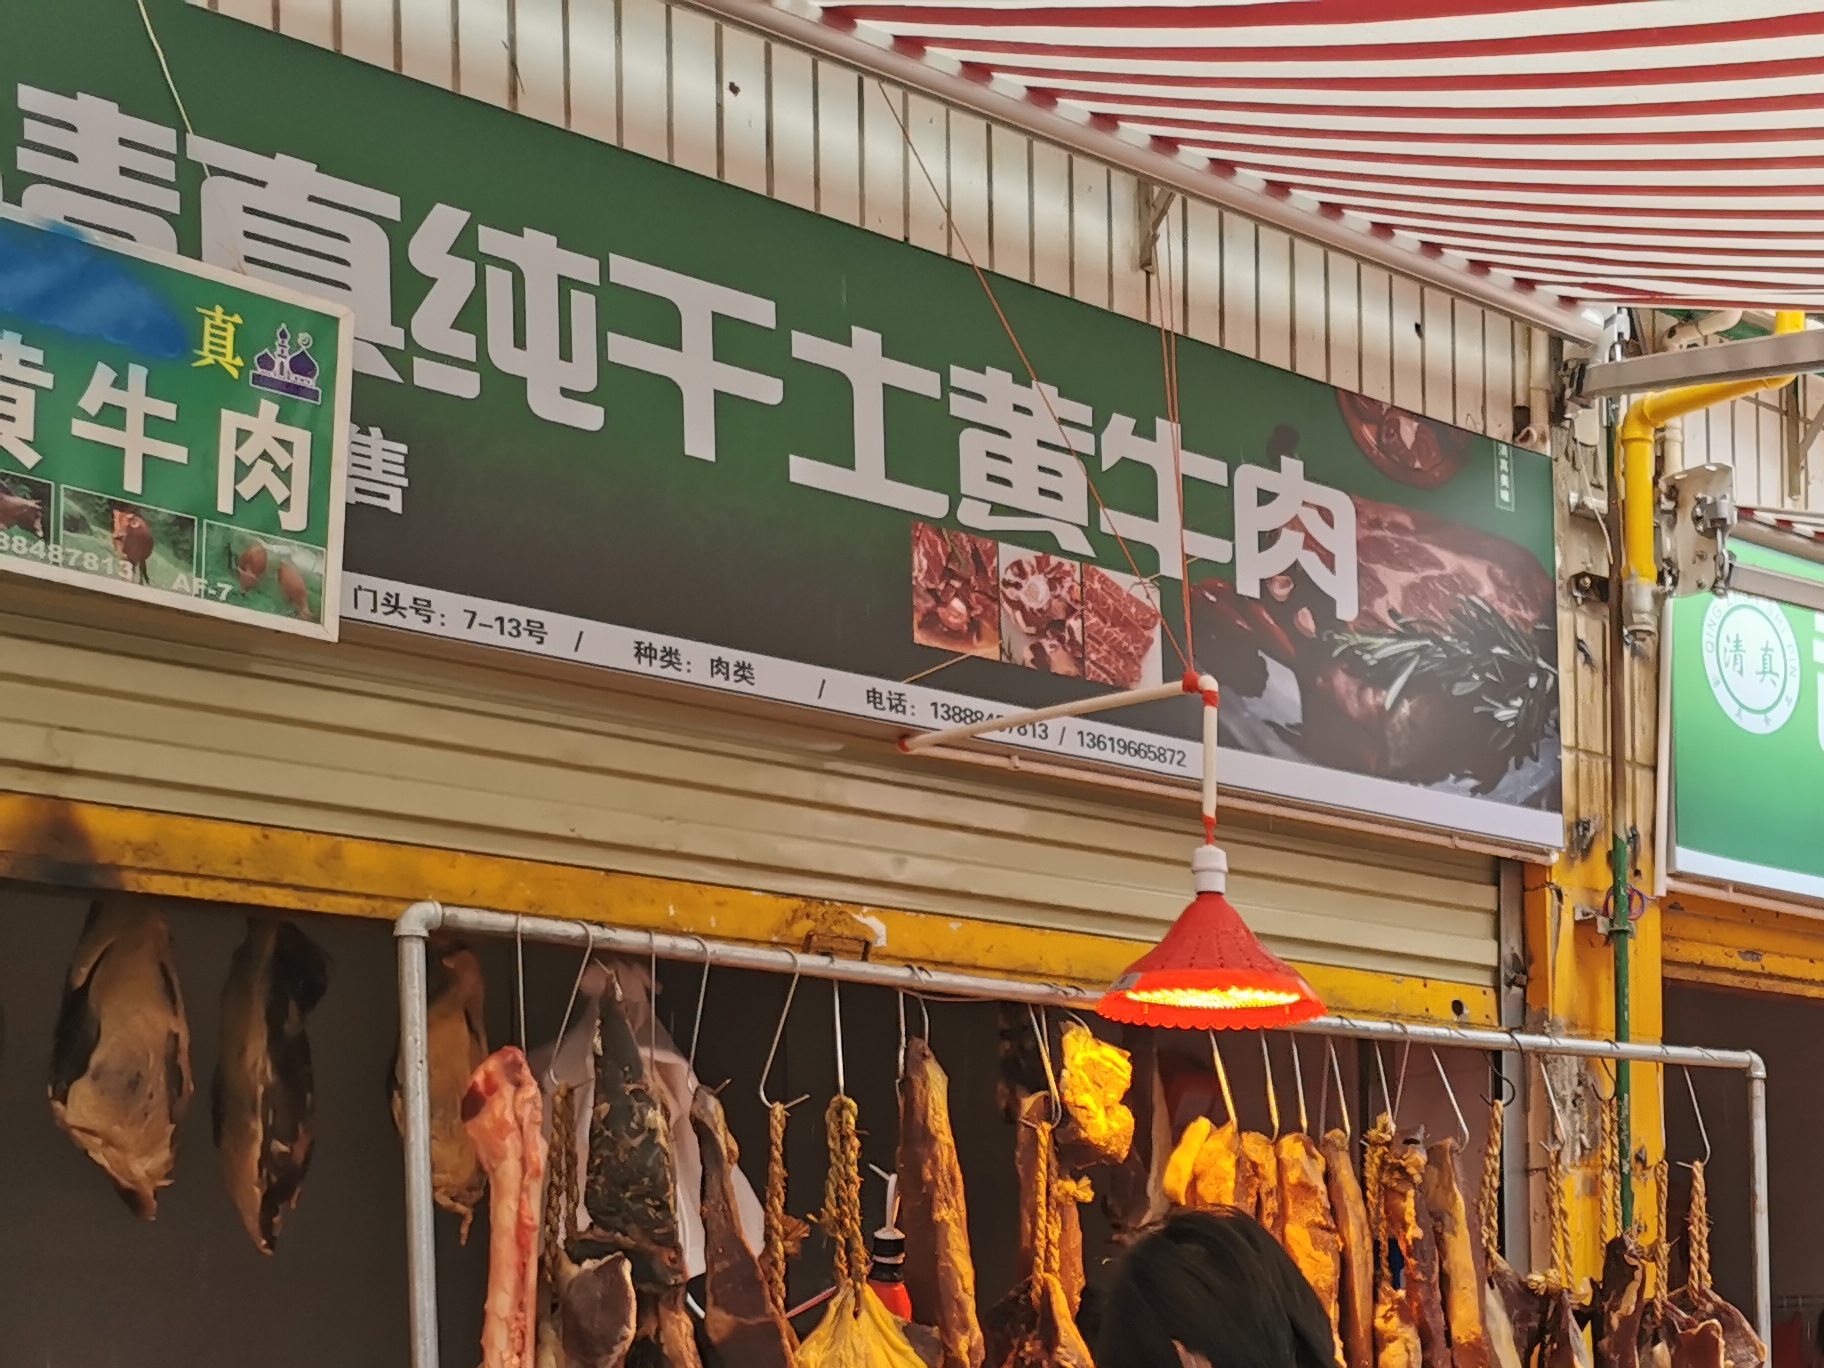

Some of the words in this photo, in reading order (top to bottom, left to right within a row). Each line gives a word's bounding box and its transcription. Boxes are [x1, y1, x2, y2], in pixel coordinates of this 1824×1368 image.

[191, 305, 243, 379] 真
[1722, 632, 1781, 688] 清真
[1077, 730, 1188, 768] 13619665872
